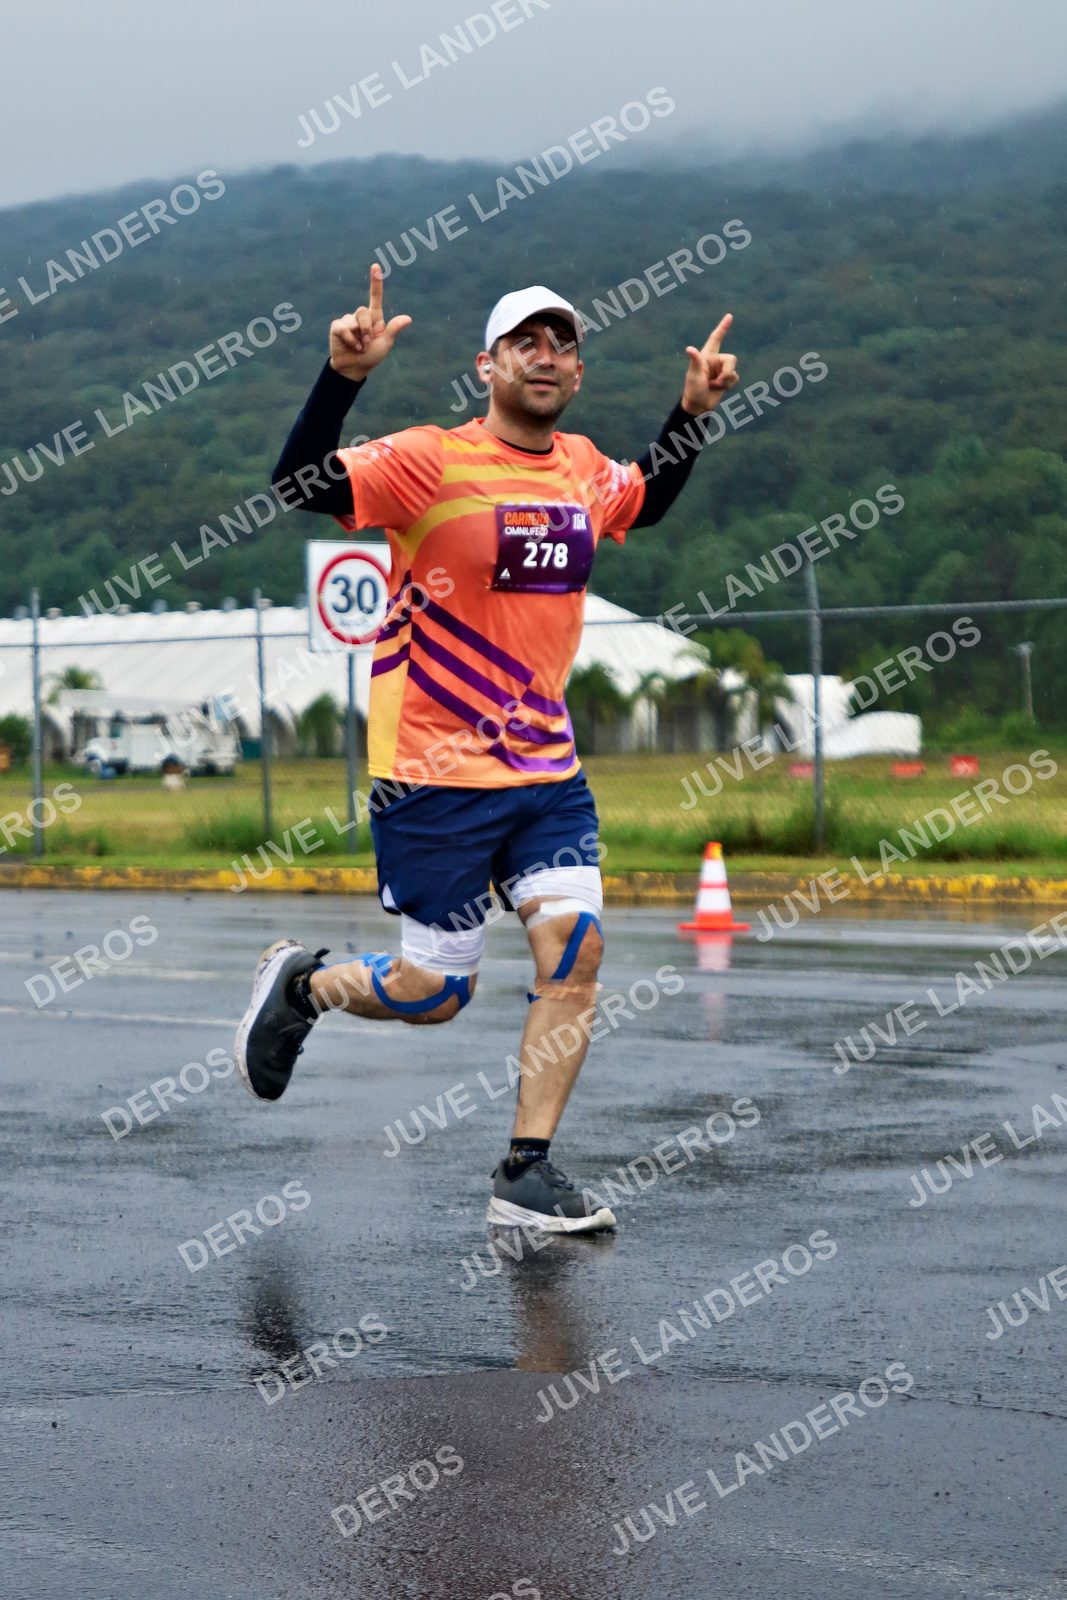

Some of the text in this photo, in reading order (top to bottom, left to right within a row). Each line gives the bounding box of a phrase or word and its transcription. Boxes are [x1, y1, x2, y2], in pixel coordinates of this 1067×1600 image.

[504, 526, 539, 537] OMNILIFE
[523, 541, 568, 569] 278
[331, 575, 380, 614] 30
